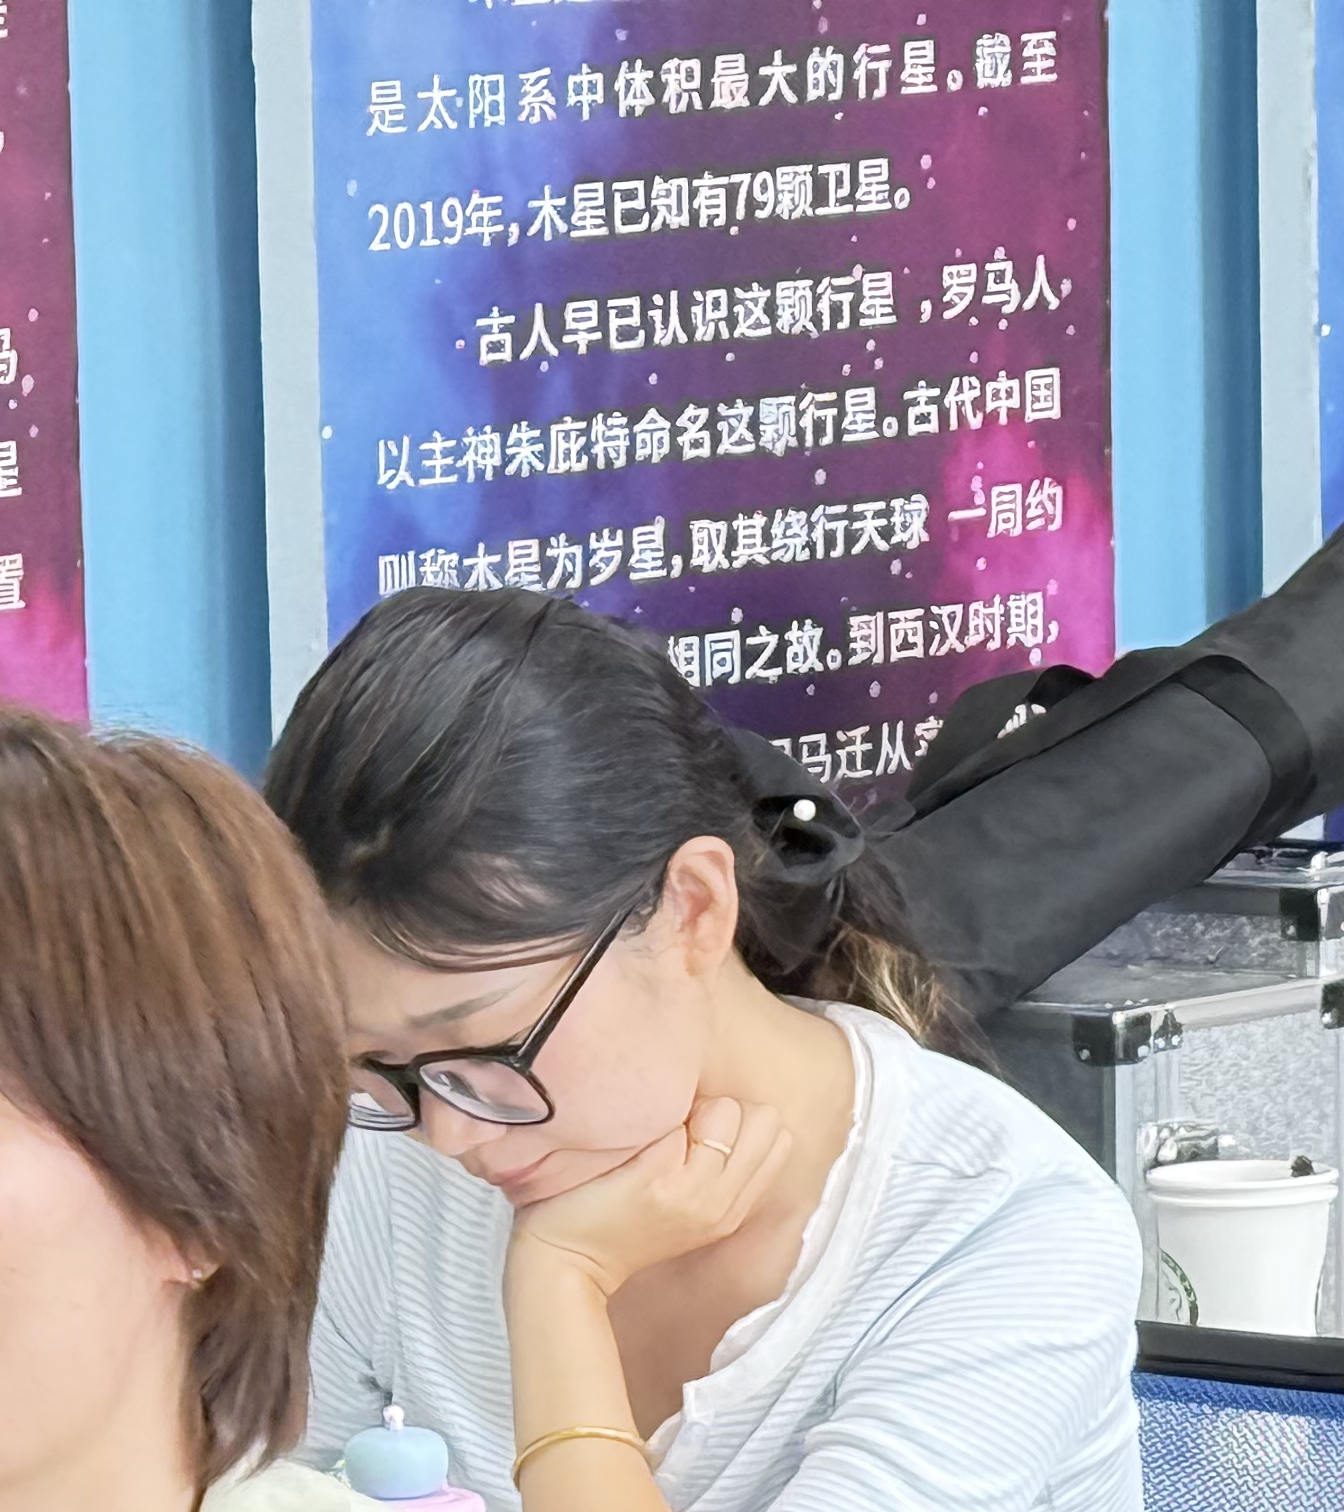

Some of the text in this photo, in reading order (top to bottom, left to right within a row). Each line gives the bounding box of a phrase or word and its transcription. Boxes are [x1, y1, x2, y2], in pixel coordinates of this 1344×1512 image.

[368, 157, 911, 254] 2019年，木星已知有79颗卫星。
